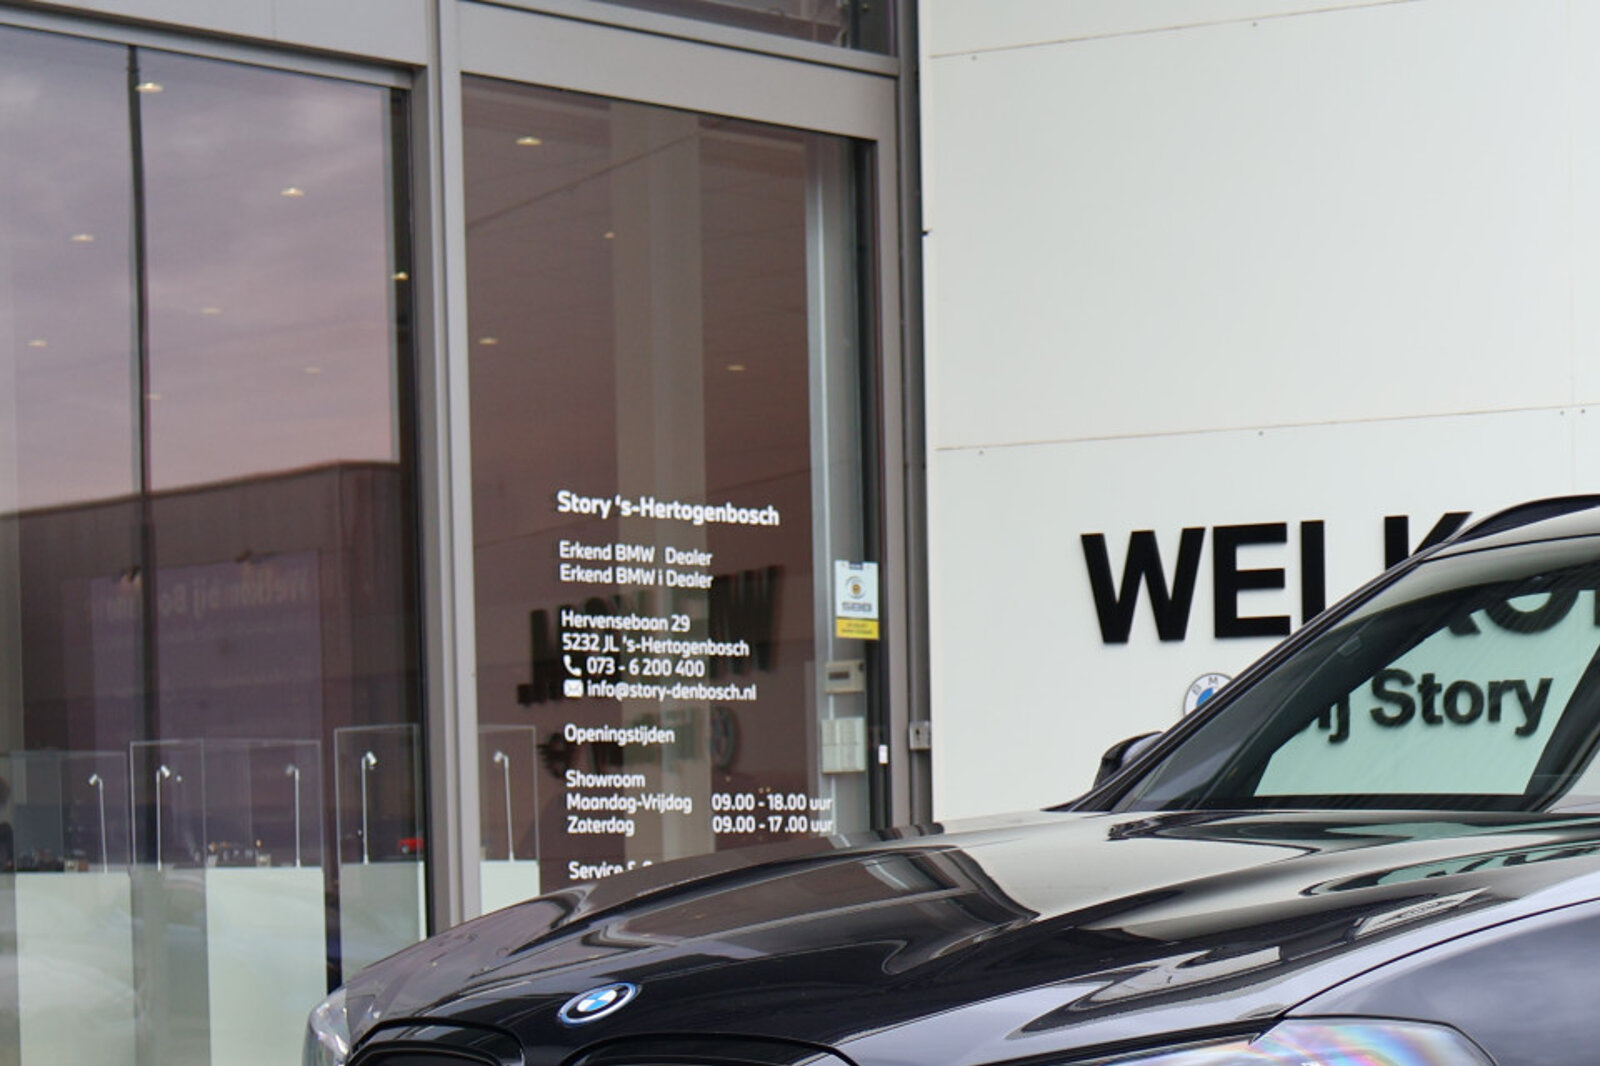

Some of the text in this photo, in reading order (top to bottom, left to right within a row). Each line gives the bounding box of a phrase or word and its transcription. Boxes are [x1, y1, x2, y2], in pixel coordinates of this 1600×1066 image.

[557, 490, 612, 519] Story
[559, 540, 713, 567] Erkend BMW Dealer
[560, 563, 713, 589] Erkend BMW i Dealer
[561, 610, 690, 633] Hervensebaan 29
[562, 634, 600, 652] 5232
[601, 635, 619, 654] JL
[587, 656, 615, 675] 073
[629, 658, 640, 676] 6
[642, 658, 672, 677] 200
[675, 659, 705, 678] 400
[587, 680, 756, 702] info@story-denbosch.nl
[1369, 668, 1555, 738] Story
[564, 723, 675, 746] Openingstijden
[566, 769, 645, 788] Showroom
[566, 793, 692, 816] Maandag-Vrijdag
[712, 793, 755, 811] 09.00
[767, 793, 807, 811] 18.00
[809, 798, 833, 811] uur
[567, 815, 636, 837] Zaterdag
[713, 815, 756, 833] 09.00
[811, 820, 834, 833] uur
